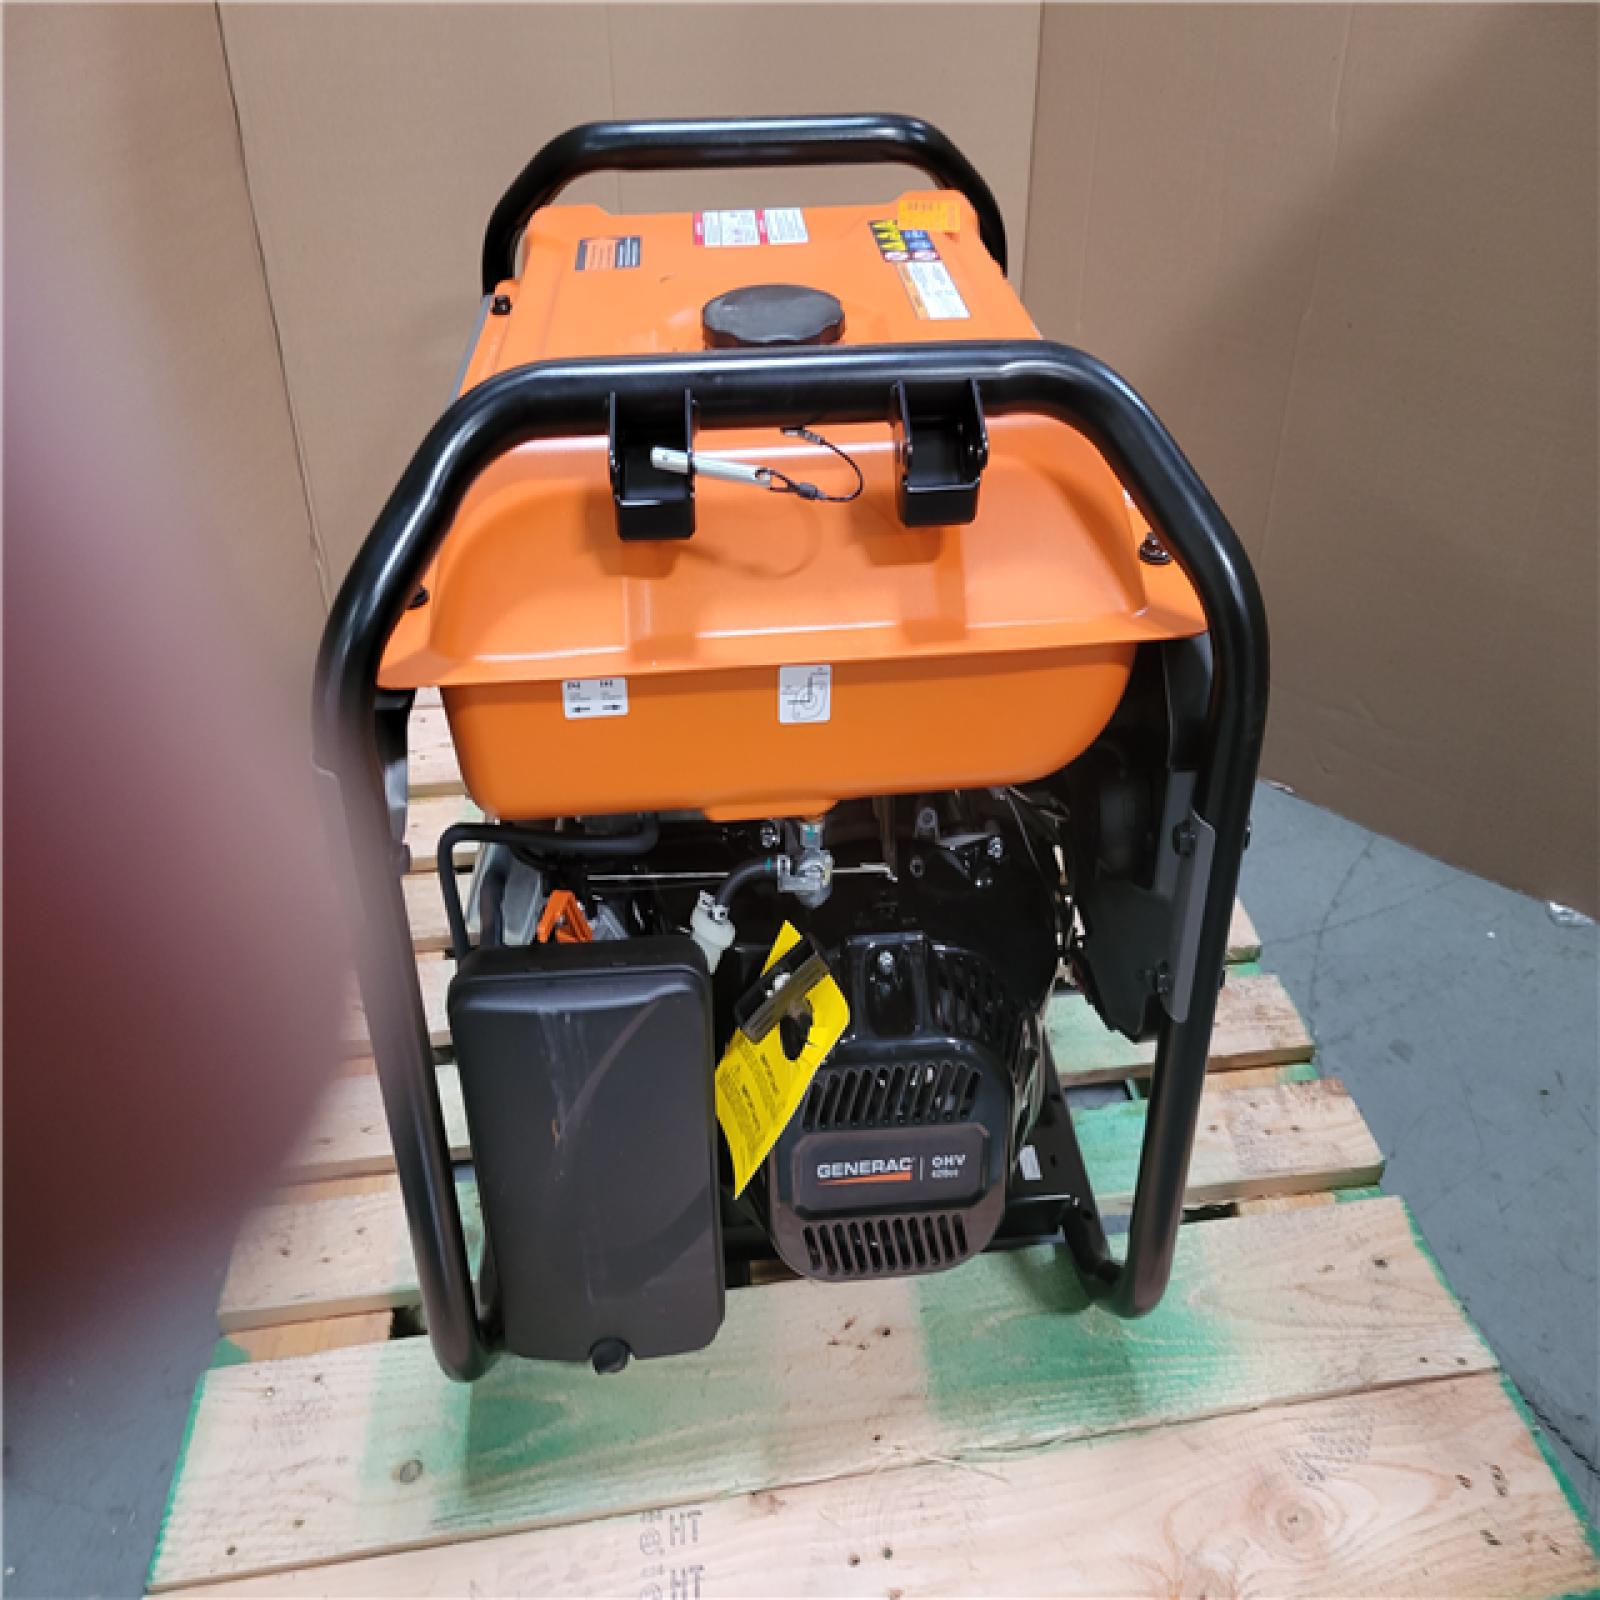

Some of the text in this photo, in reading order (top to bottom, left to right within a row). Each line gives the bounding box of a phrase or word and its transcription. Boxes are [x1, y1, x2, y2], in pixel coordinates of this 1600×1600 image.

[816, 1154, 966, 1179] GENERAC OHV
[669, 1509, 704, 1546] HT
